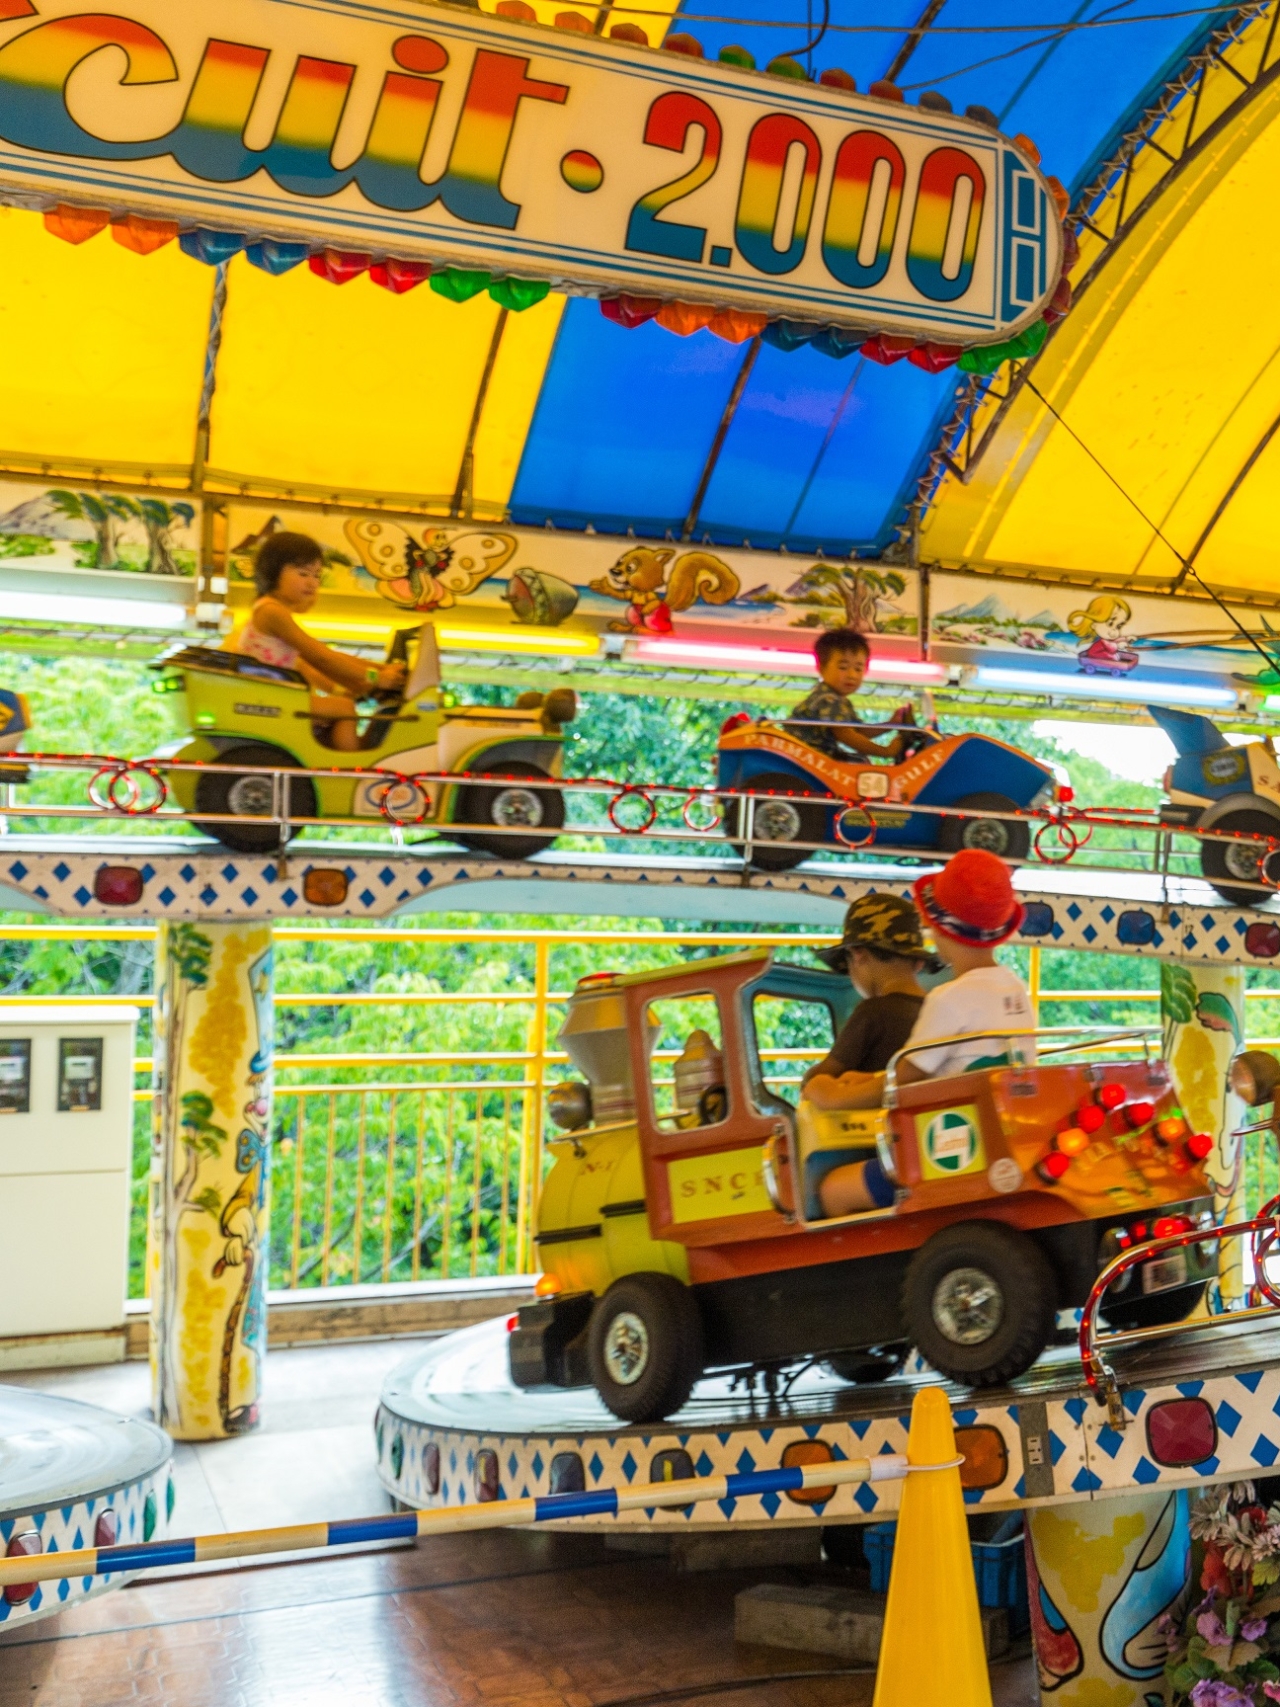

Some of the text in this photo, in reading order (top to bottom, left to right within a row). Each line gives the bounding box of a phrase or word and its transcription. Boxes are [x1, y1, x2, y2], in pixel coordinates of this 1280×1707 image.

[0, 0, 987, 302] cuit 2.000
[744, 734, 856, 787] PARMALAT
[893, 749, 945, 789] GULF
